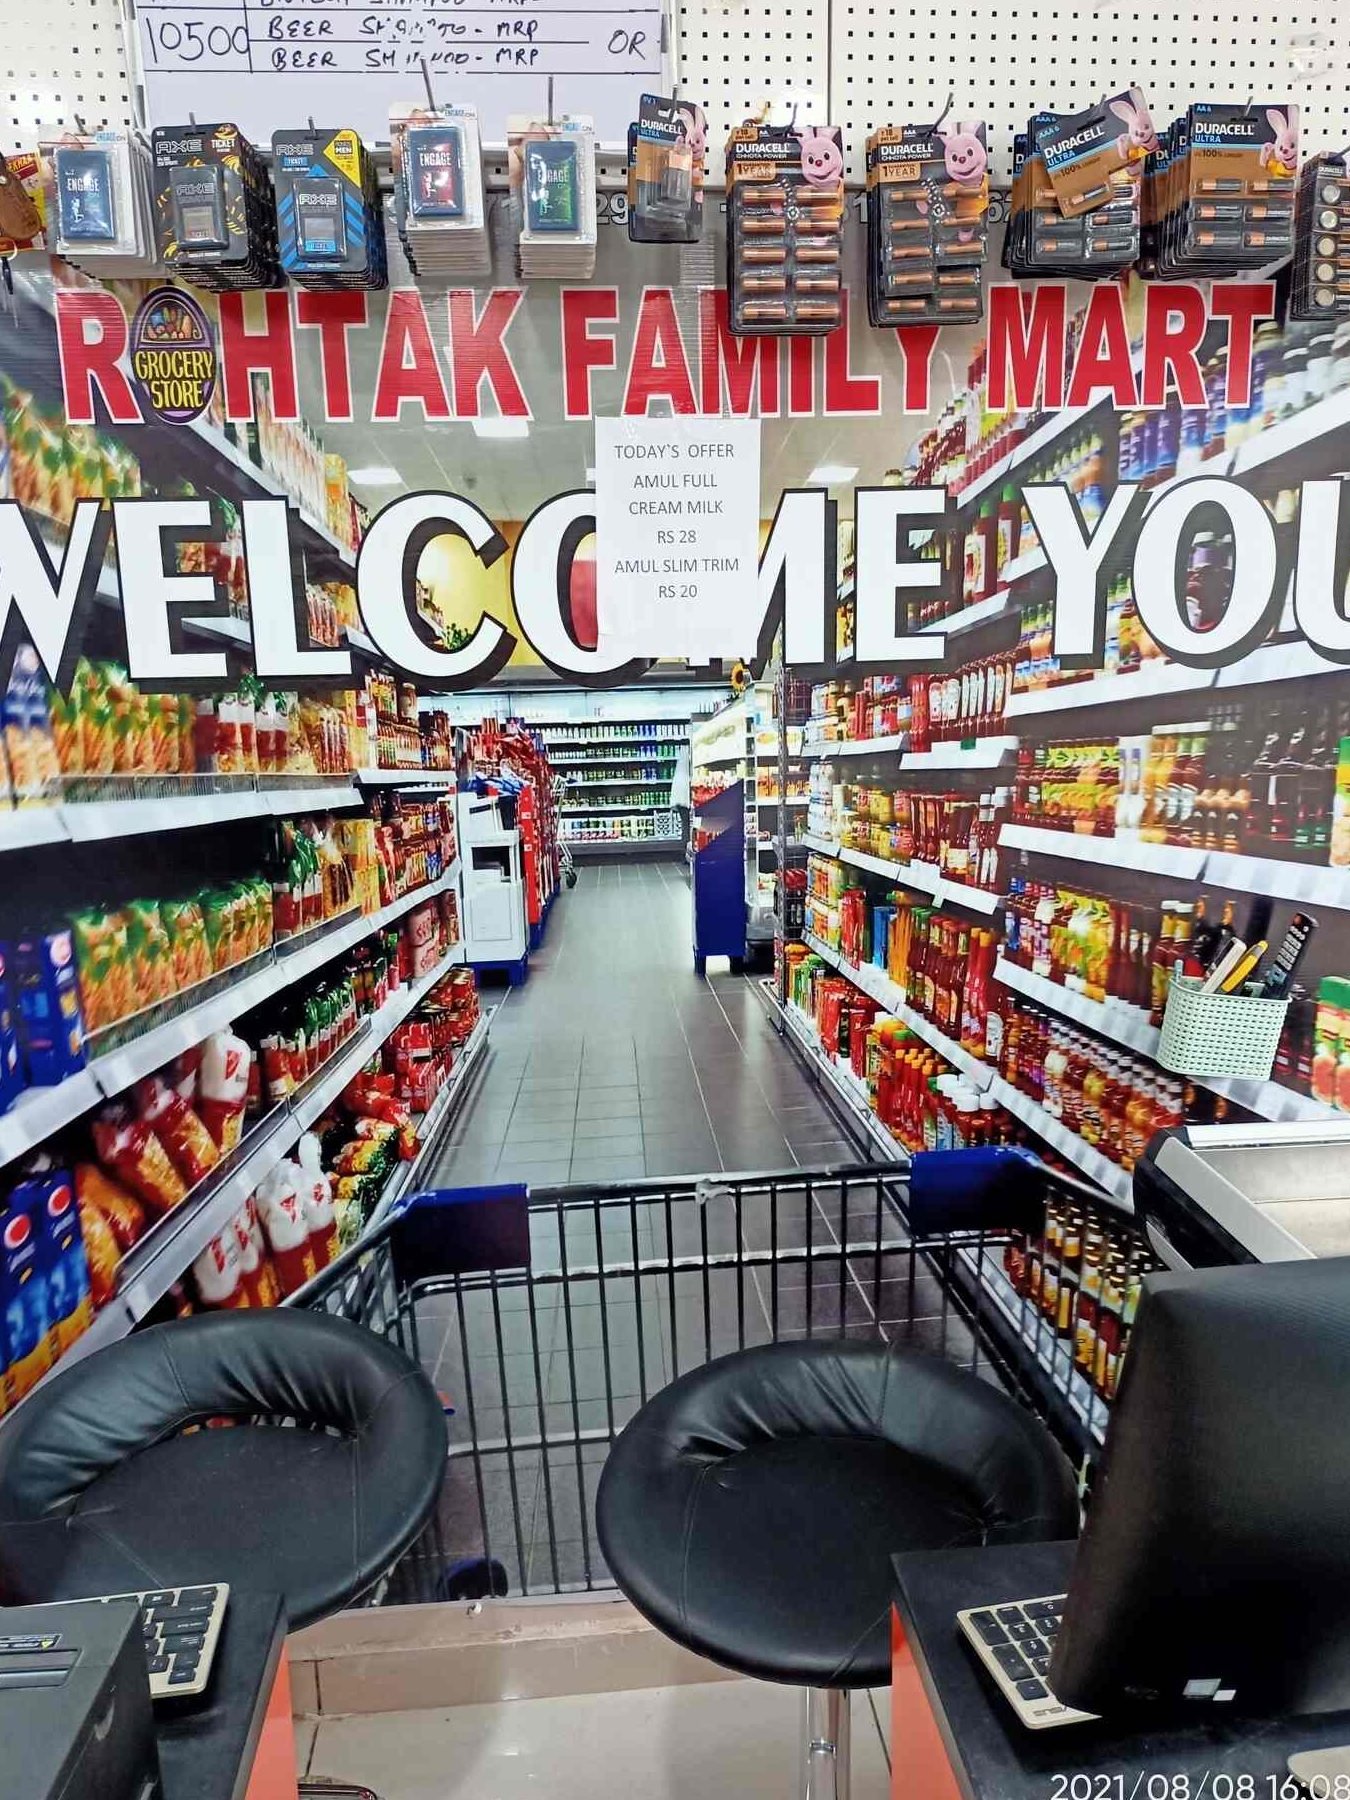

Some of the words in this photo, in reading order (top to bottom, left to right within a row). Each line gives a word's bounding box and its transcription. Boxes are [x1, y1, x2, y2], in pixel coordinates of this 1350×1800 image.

[268, 16, 333, 39] BEER
[497, 19, 538, 41] MRP
[146, 17, 249, 63] 10500
[608, 29, 646, 60] OR
[272, 48, 337, 70] BEER
[496, 48, 538, 65] MRP
[641, 119, 683, 135] DURACELL
[1195, 123, 1254, 136] DURACELL
[211, 139, 235, 149] TICKET
[1044, 126, 1105, 159] DURACELL
[1195, 135, 1221, 143] ULTRA
[155, 139, 202, 154] AXE
[276, 144, 314, 156] AXE
[736, 143, 787, 153] DURACELL
[881, 144, 934, 155] DURACELL
[420, 153, 452, 167] ENGAGE
[1047, 150, 1075, 166] ULTRA
[889, 167, 916, 176] YEAR
[67, 179, 100, 192] ENGAGE
[298, 194, 337, 205] AXE
[986, 281, 1278, 413] MART
[135, 350, 213, 380] GROCERY
[150, 380, 204, 409] STORE
[688, 444, 734, 458] OFFER
[633, 474, 679, 488] AMUL
[683, 474, 718, 488] FULL
[629, 501, 682, 515] CREAM
[687, 500, 724, 514] MILK
[657, 530, 674, 543] RS
[679, 530, 697, 543] 28
[614, 560, 659, 574] AMUL
[663, 559, 697, 573] SLIM
[702, 558, 739, 572] TRIM
[658, 585, 676, 598] RS
[680, 585, 698, 598] 20
